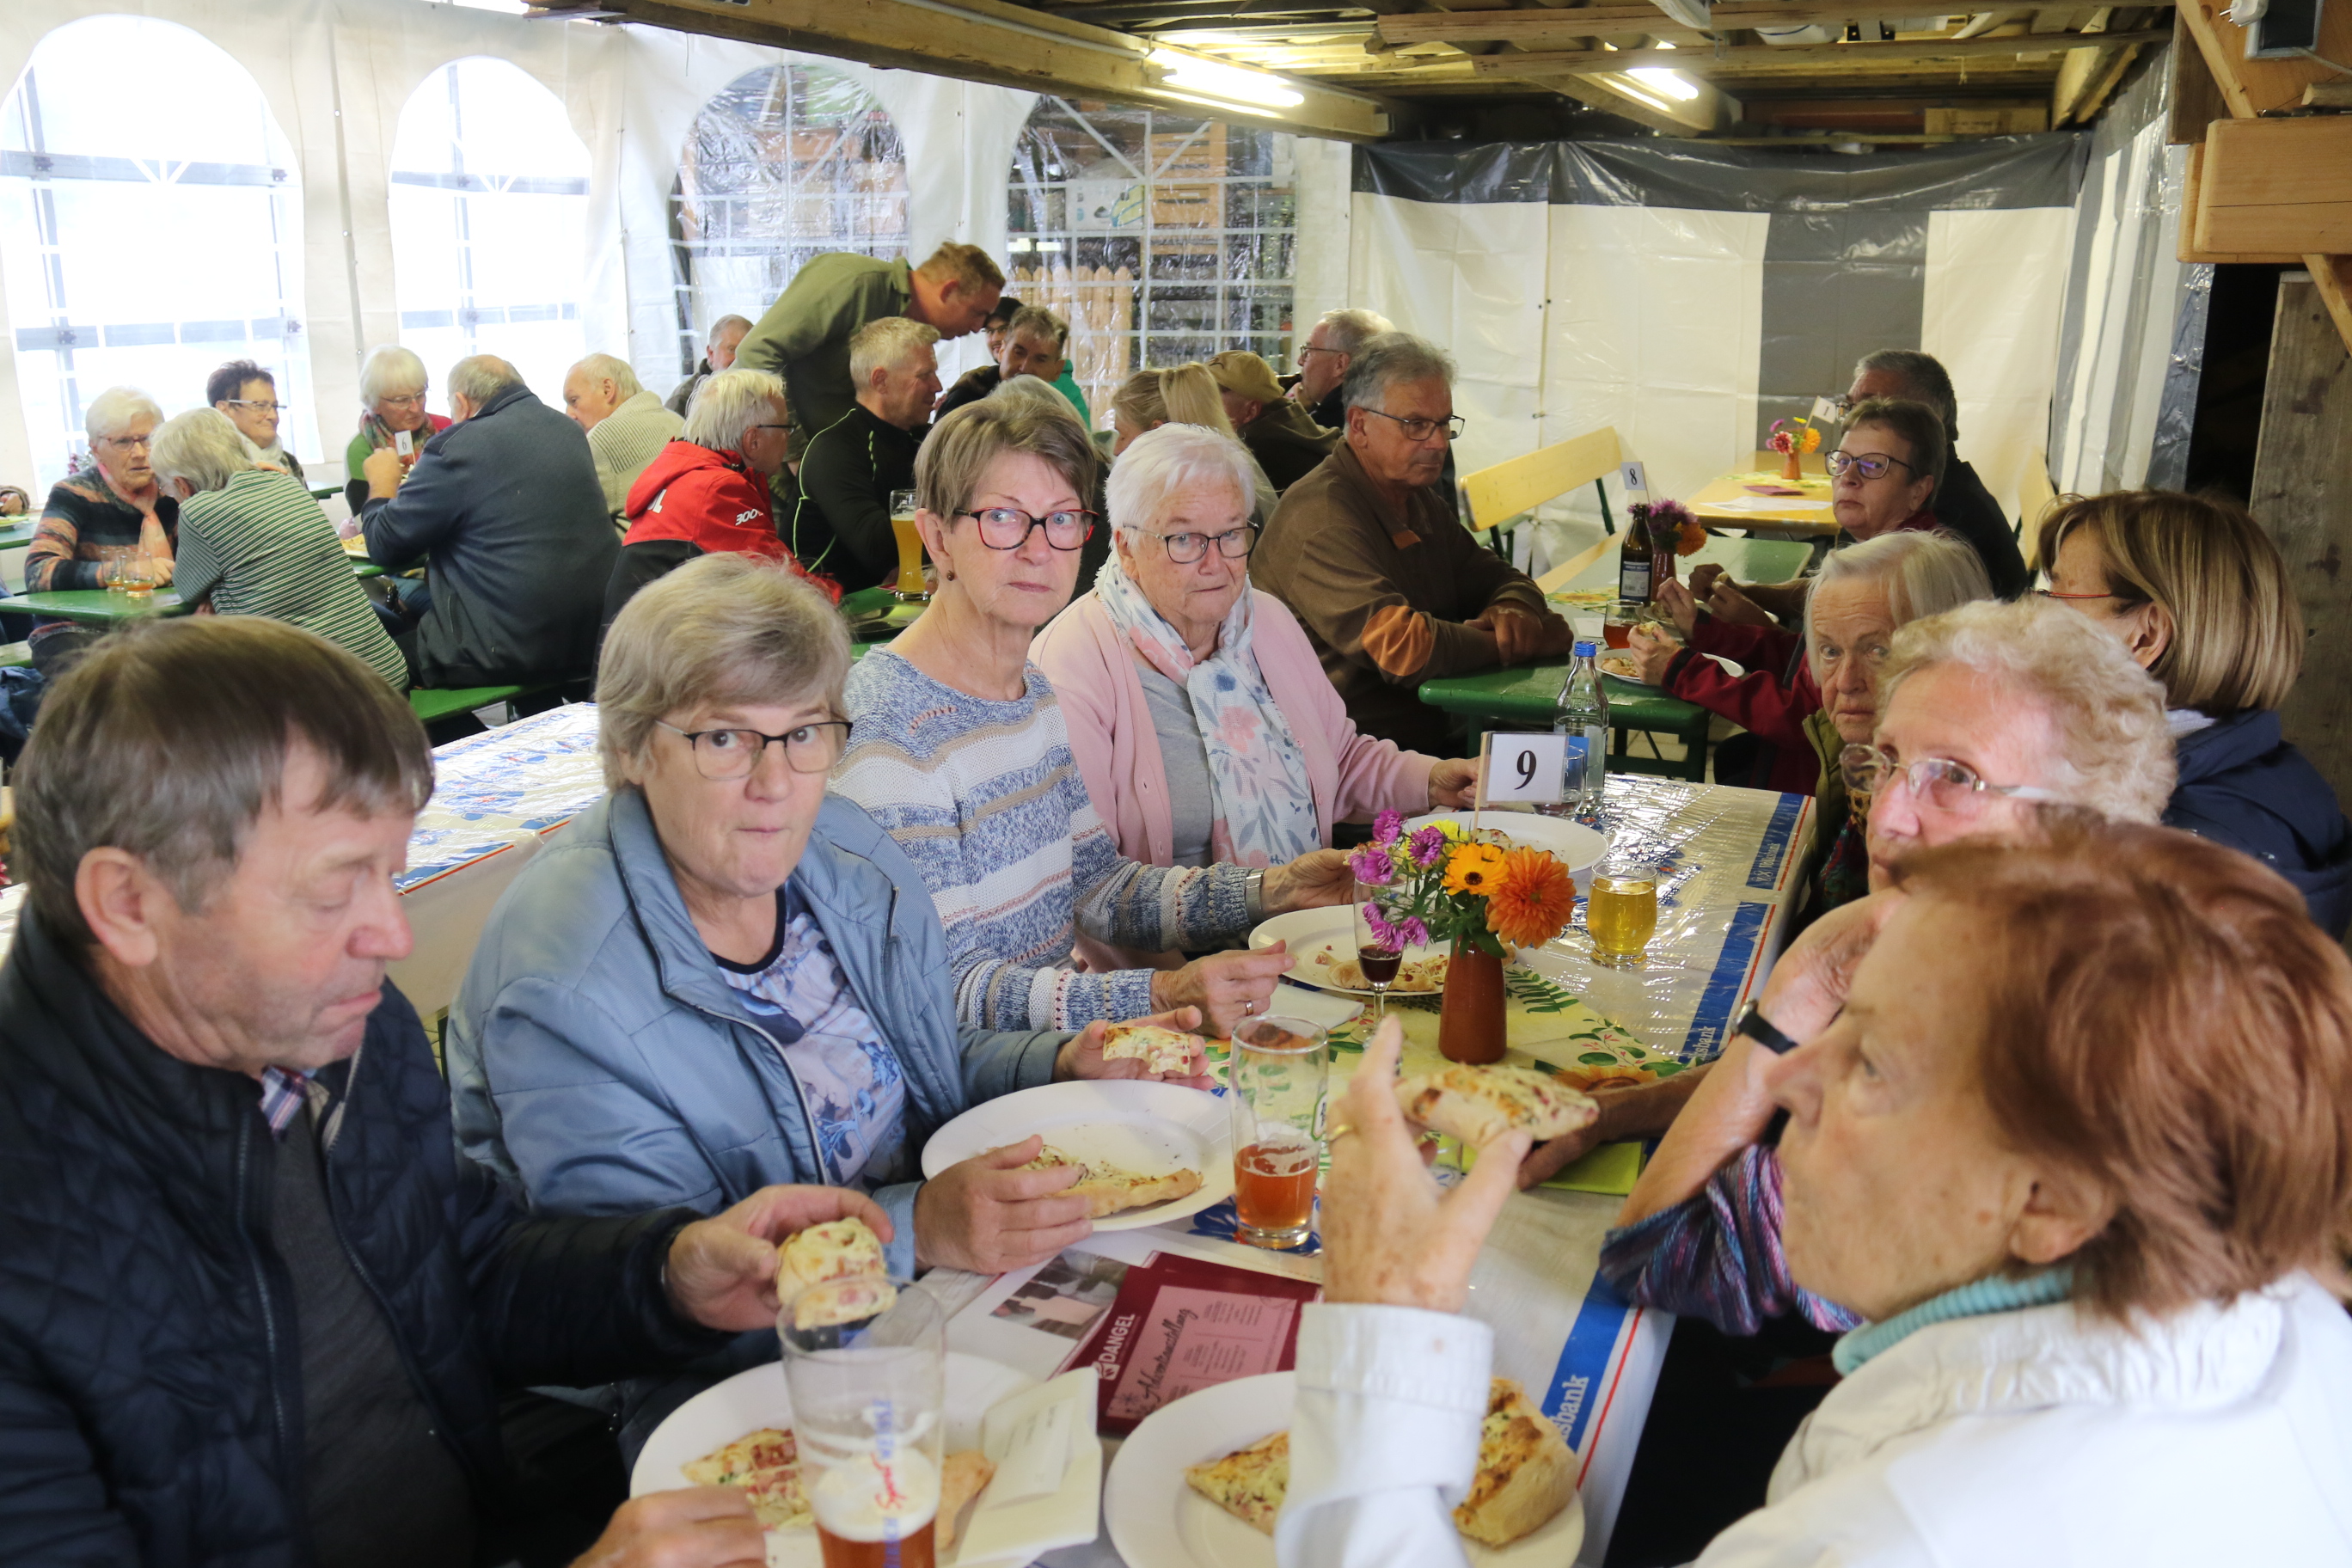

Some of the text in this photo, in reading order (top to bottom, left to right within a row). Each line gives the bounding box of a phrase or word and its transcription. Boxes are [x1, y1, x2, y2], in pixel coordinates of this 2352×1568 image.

[401, 437, 407, 451] 6
[1629, 468, 1638, 486] 8
[735, 508, 758, 526] 300
[1514, 750, 1537, 790] 9
[1104, 1314, 1136, 1363] DANGEL
[1549, 1374, 1589, 1443] sbank
